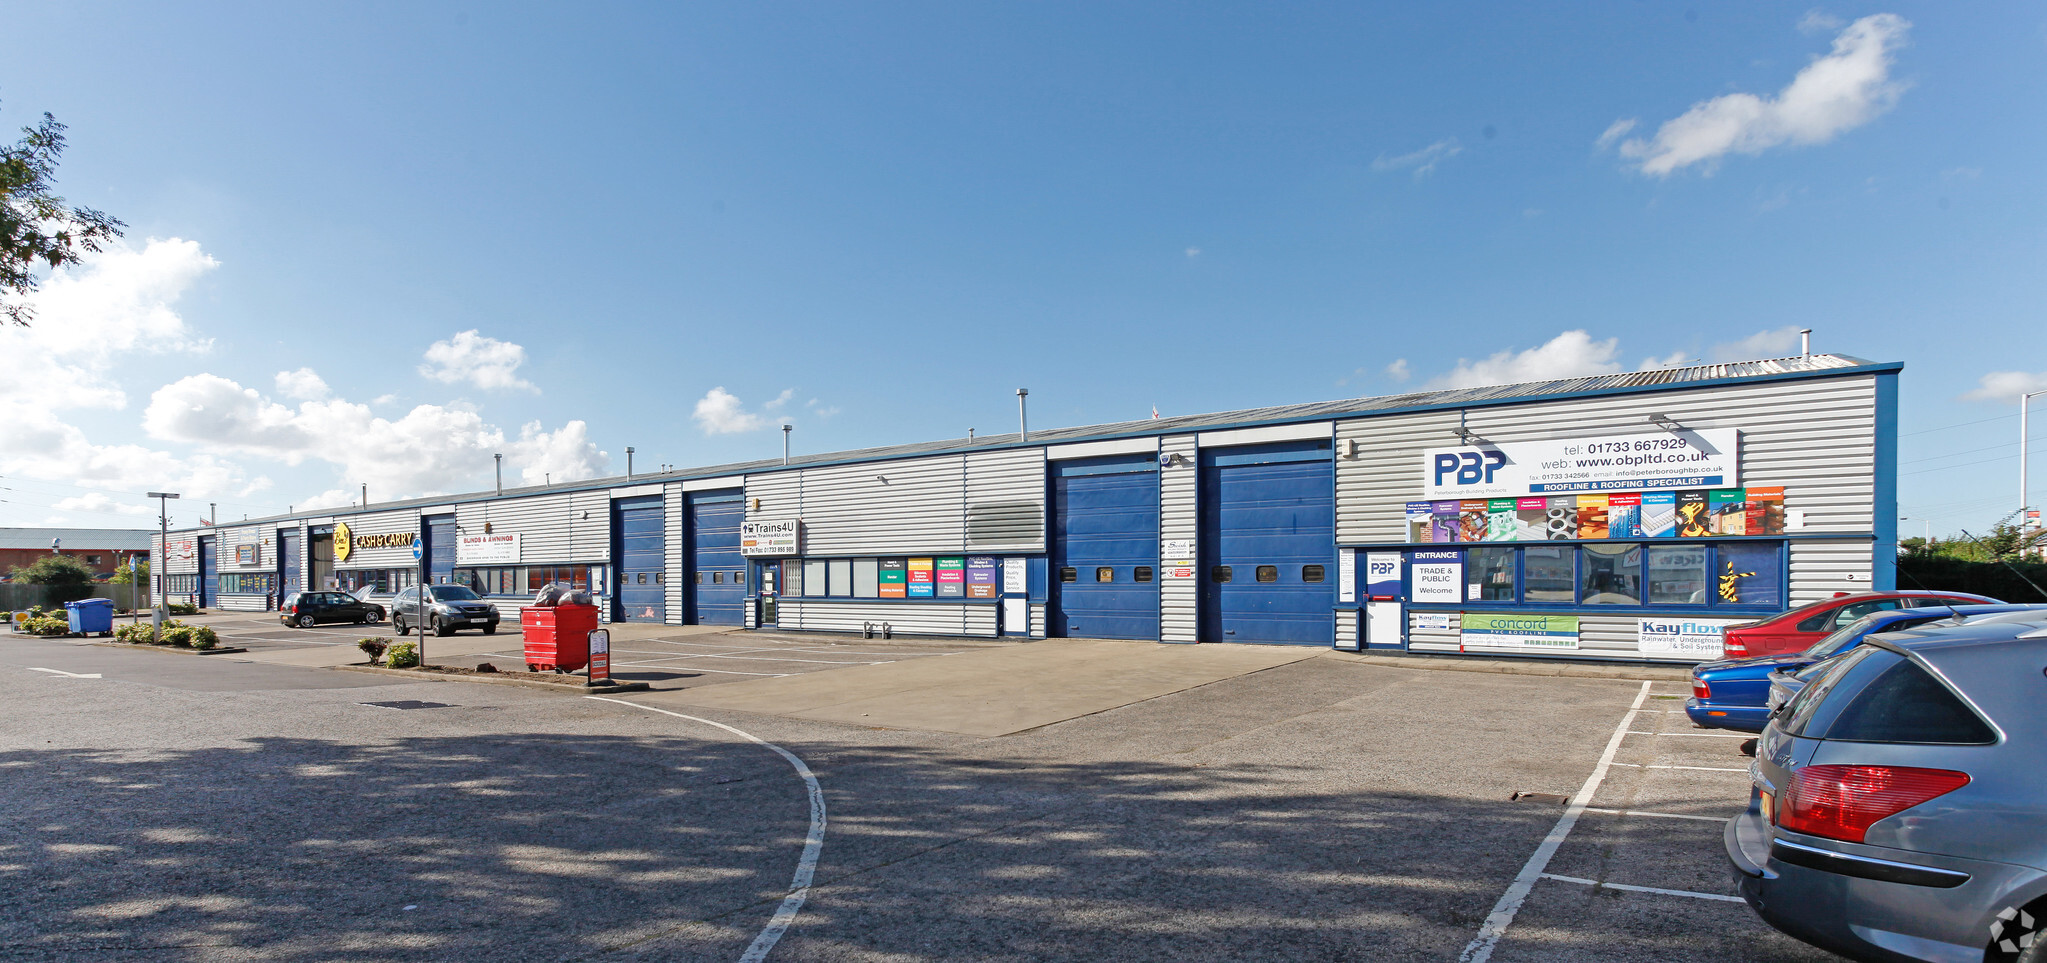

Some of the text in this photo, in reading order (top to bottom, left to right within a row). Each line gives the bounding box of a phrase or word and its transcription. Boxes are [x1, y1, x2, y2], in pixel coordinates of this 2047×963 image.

[1564, 438, 1687, 455] tel: 01733 667929
[1541, 450, 1709, 470] web: www.obpltd.co.uk
[1434, 450, 1507, 487] PBP
[1615, 466, 1723, 477] info@peterboroughbp.co.uk
[1544, 482, 1590, 491] ROOFLINE
[1600, 480, 1644, 488] ROOFING
[1647, 478, 1705, 486] SPECIALIST
[756, 522, 793, 532] Trains4U
[1371, 563, 1395, 574] PBP
[1490, 617, 1547, 630] concord
